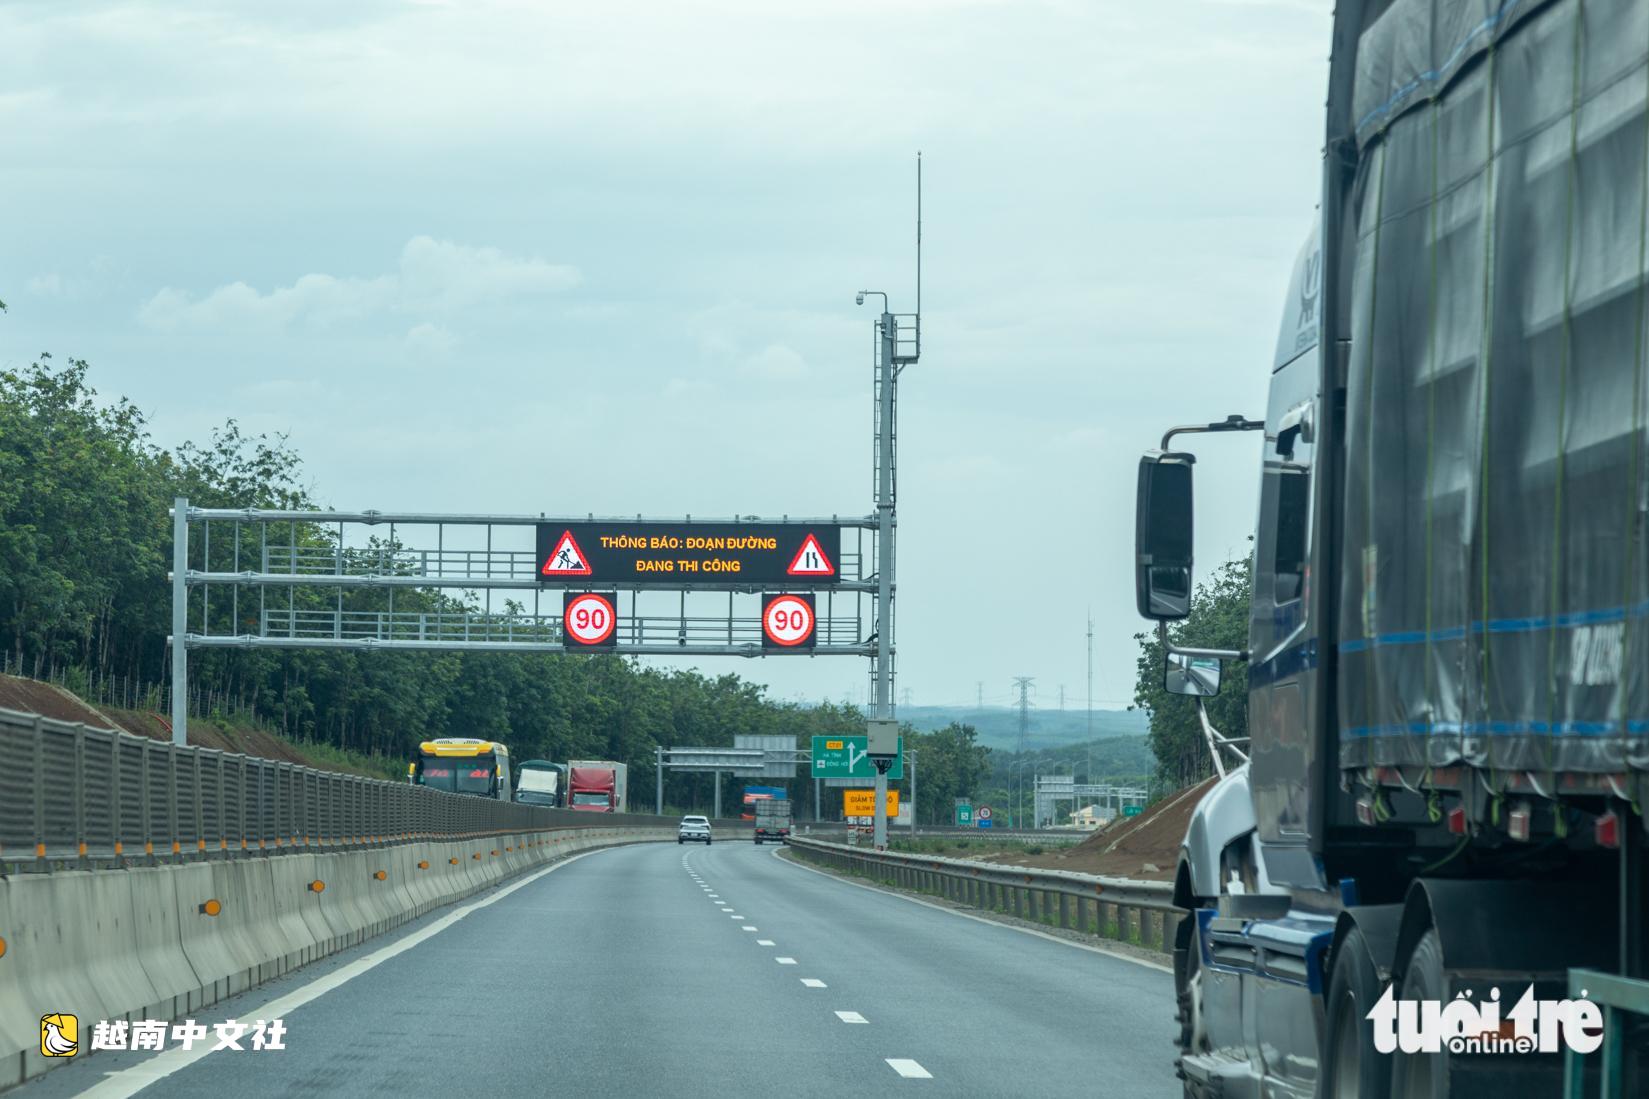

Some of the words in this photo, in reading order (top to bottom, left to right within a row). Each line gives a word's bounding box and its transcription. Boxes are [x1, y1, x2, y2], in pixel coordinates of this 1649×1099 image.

[600, 535, 647, 549] THÔNG
[650, 535, 683, 549] BÁO:
[686, 537, 725, 551] ĐOẠN
[727, 535, 777, 550] ĐƯỜNG
[636, 560, 674, 572] ĐANG
[678, 560, 698, 572] THI
[702, 558, 741, 572] CÔNG
[576, 608, 605, 630] 90
[774, 610, 804, 631] 90
